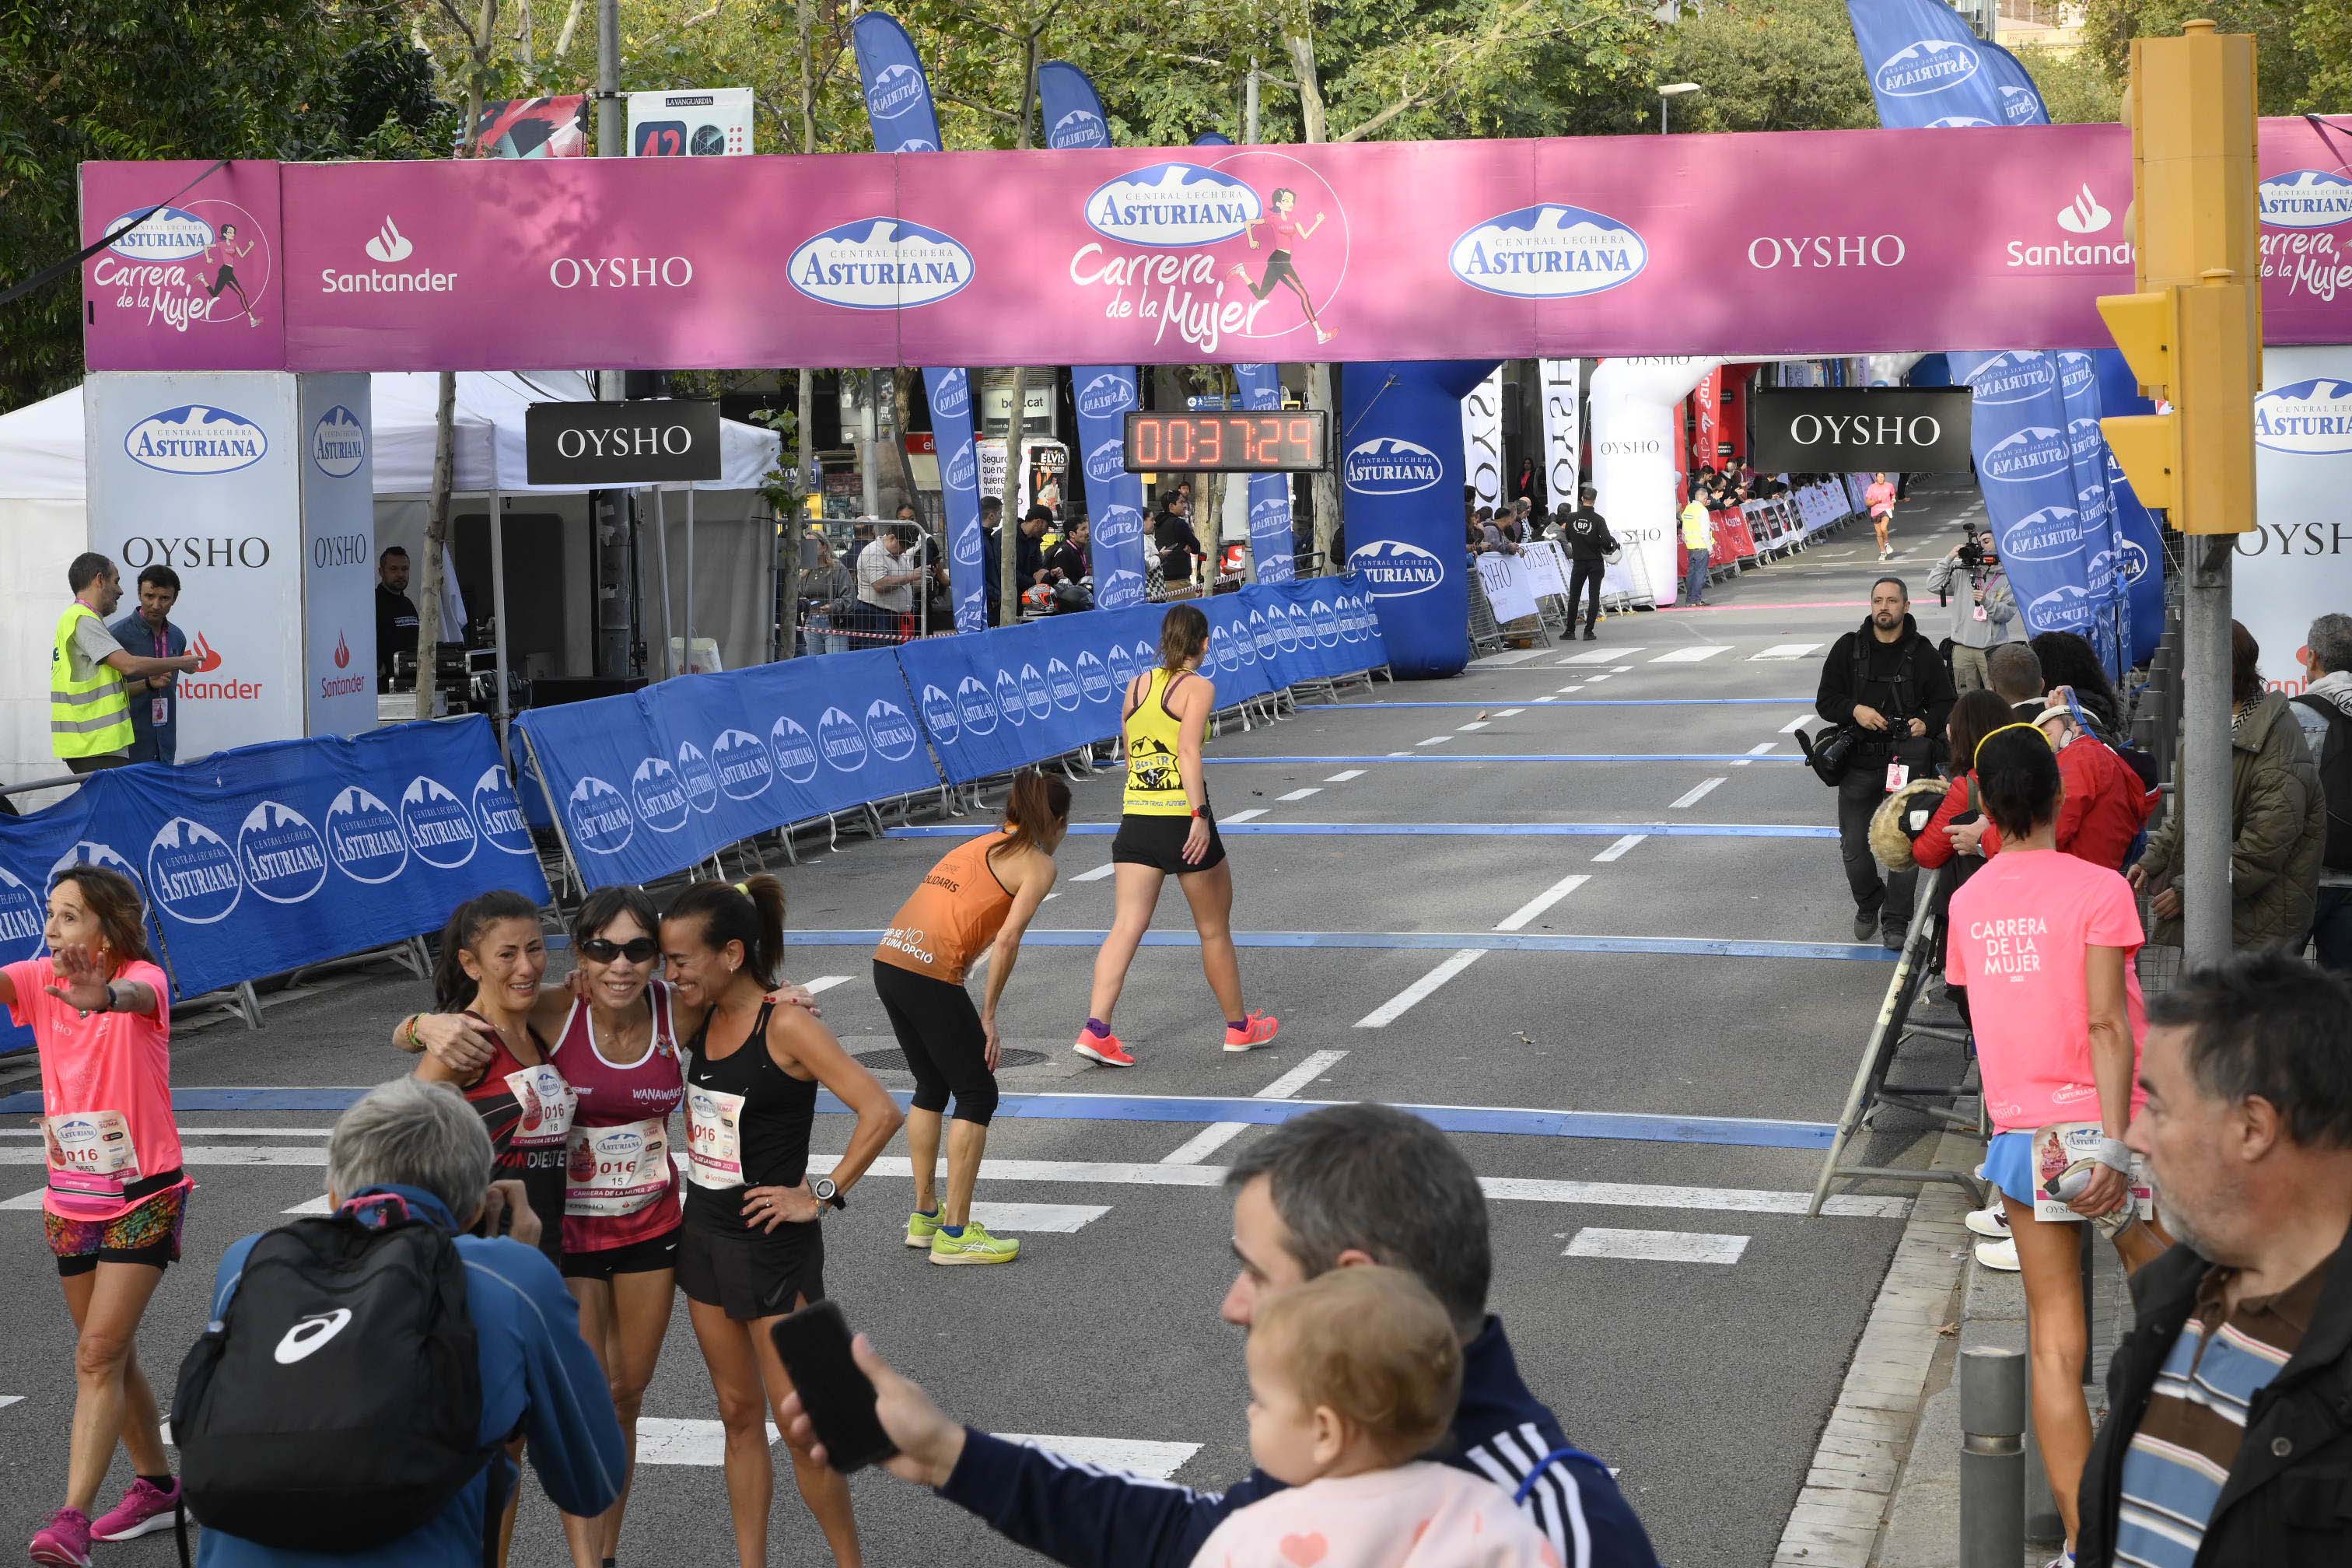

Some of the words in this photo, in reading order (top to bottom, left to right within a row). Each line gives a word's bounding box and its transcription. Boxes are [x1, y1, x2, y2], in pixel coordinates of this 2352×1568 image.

[1125, 191, 1182, 200] CENTRAL
[1187, 190, 1244, 199] LECHERA
[1099, 194, 1246, 226] ASTURIANA
[1496, 237, 1555, 246] CENTRAL
[1562, 236, 1626, 244] LECHERA
[1748, 234, 1906, 268] OYSHO
[2260, 233, 2334, 255] arrera
[830, 250, 889, 258] CENTRAL
[894, 249, 953, 257] LECHERA
[1069, 243, 1215, 286] Carrera
[1465, 240, 1632, 275] ASTURIANA
[94, 257, 187, 287] Carrera
[550, 257, 693, 289] OYSHO
[801, 252, 959, 285] ASTURIANA
[2278, 256, 2293, 277] la
[2289, 250, 2352, 302] Muje
[322, 268, 457, 293] Santander
[117, 289, 134, 308] de
[137, 288, 150, 308] la
[148, 283, 220, 332] Mujer
[1105, 289, 1132, 319] de
[1139, 289, 1158, 318] la
[1154, 282, 1269, 354] Mujer
[557, 425, 692, 458] OYSHO
[1138, 419, 1312, 463] 00:37:29
[1790, 414, 1941, 446] OYSHO
[135, 431, 258, 457] ASTURIANA
[317, 432, 362, 460] ASTURIANA
[1601, 440, 1661, 456] OYSHO
[1041, 453, 1065, 464] ELVIS
[1348, 462, 1435, 483] ASTURIANA
[1576, 521, 1589, 530] BP
[1624, 528, 1661, 542] SHO
[122, 537, 270, 569] OYSHO
[315, 534, 366, 569] OYSHO
[1348, 562, 1436, 585] TURIANA
[175, 678, 262, 699] ntander
[321, 674, 365, 698] Santander
[822, 733, 866, 758] ASTURIANA
[716, 756, 772, 786] ASTURIANA
[414, 808, 437, 819] CENTRAL
[437, 804, 460, 816] LECHERA
[488, 796, 513, 807] CENTRAL
[341, 820, 367, 831] CENTRAL
[368, 815, 392, 828] LECHERA
[480, 802, 530, 836] ASTUR
[254, 836, 284, 849] CENTRAL
[284, 830, 312, 844] LECHERA
[408, 814, 474, 849] ASTURIANA
[333, 825, 404, 863] ASTURIANA
[166, 852, 196, 867] CENTRAL
[196, 848, 226, 863] LECHERA
[246, 843, 324, 883] ASTURIANA
[158, 861, 238, 903] ASTURIANA
[922, 874, 960, 893] OLIDARIS
[902, 926, 924, 944] NO
[1970, 917, 2048, 940] CARRERA
[887, 938, 901, 950] UNA
[901, 943, 934, 964] OPCIÓ
[1986, 938, 2011, 957] DE
[2015, 937, 2036, 954] LA
[1984, 954, 2041, 975] MUJER
[632, 1086, 682, 1101] WANAWAKE
[544, 1103, 564, 1120] 016
[550, 1123, 558, 1132] 18
[695, 1125, 716, 1141] 016
[66, 1148, 99, 1162] 016
[600, 1161, 636, 1174] 016
[612, 1177, 623, 1186] 15
